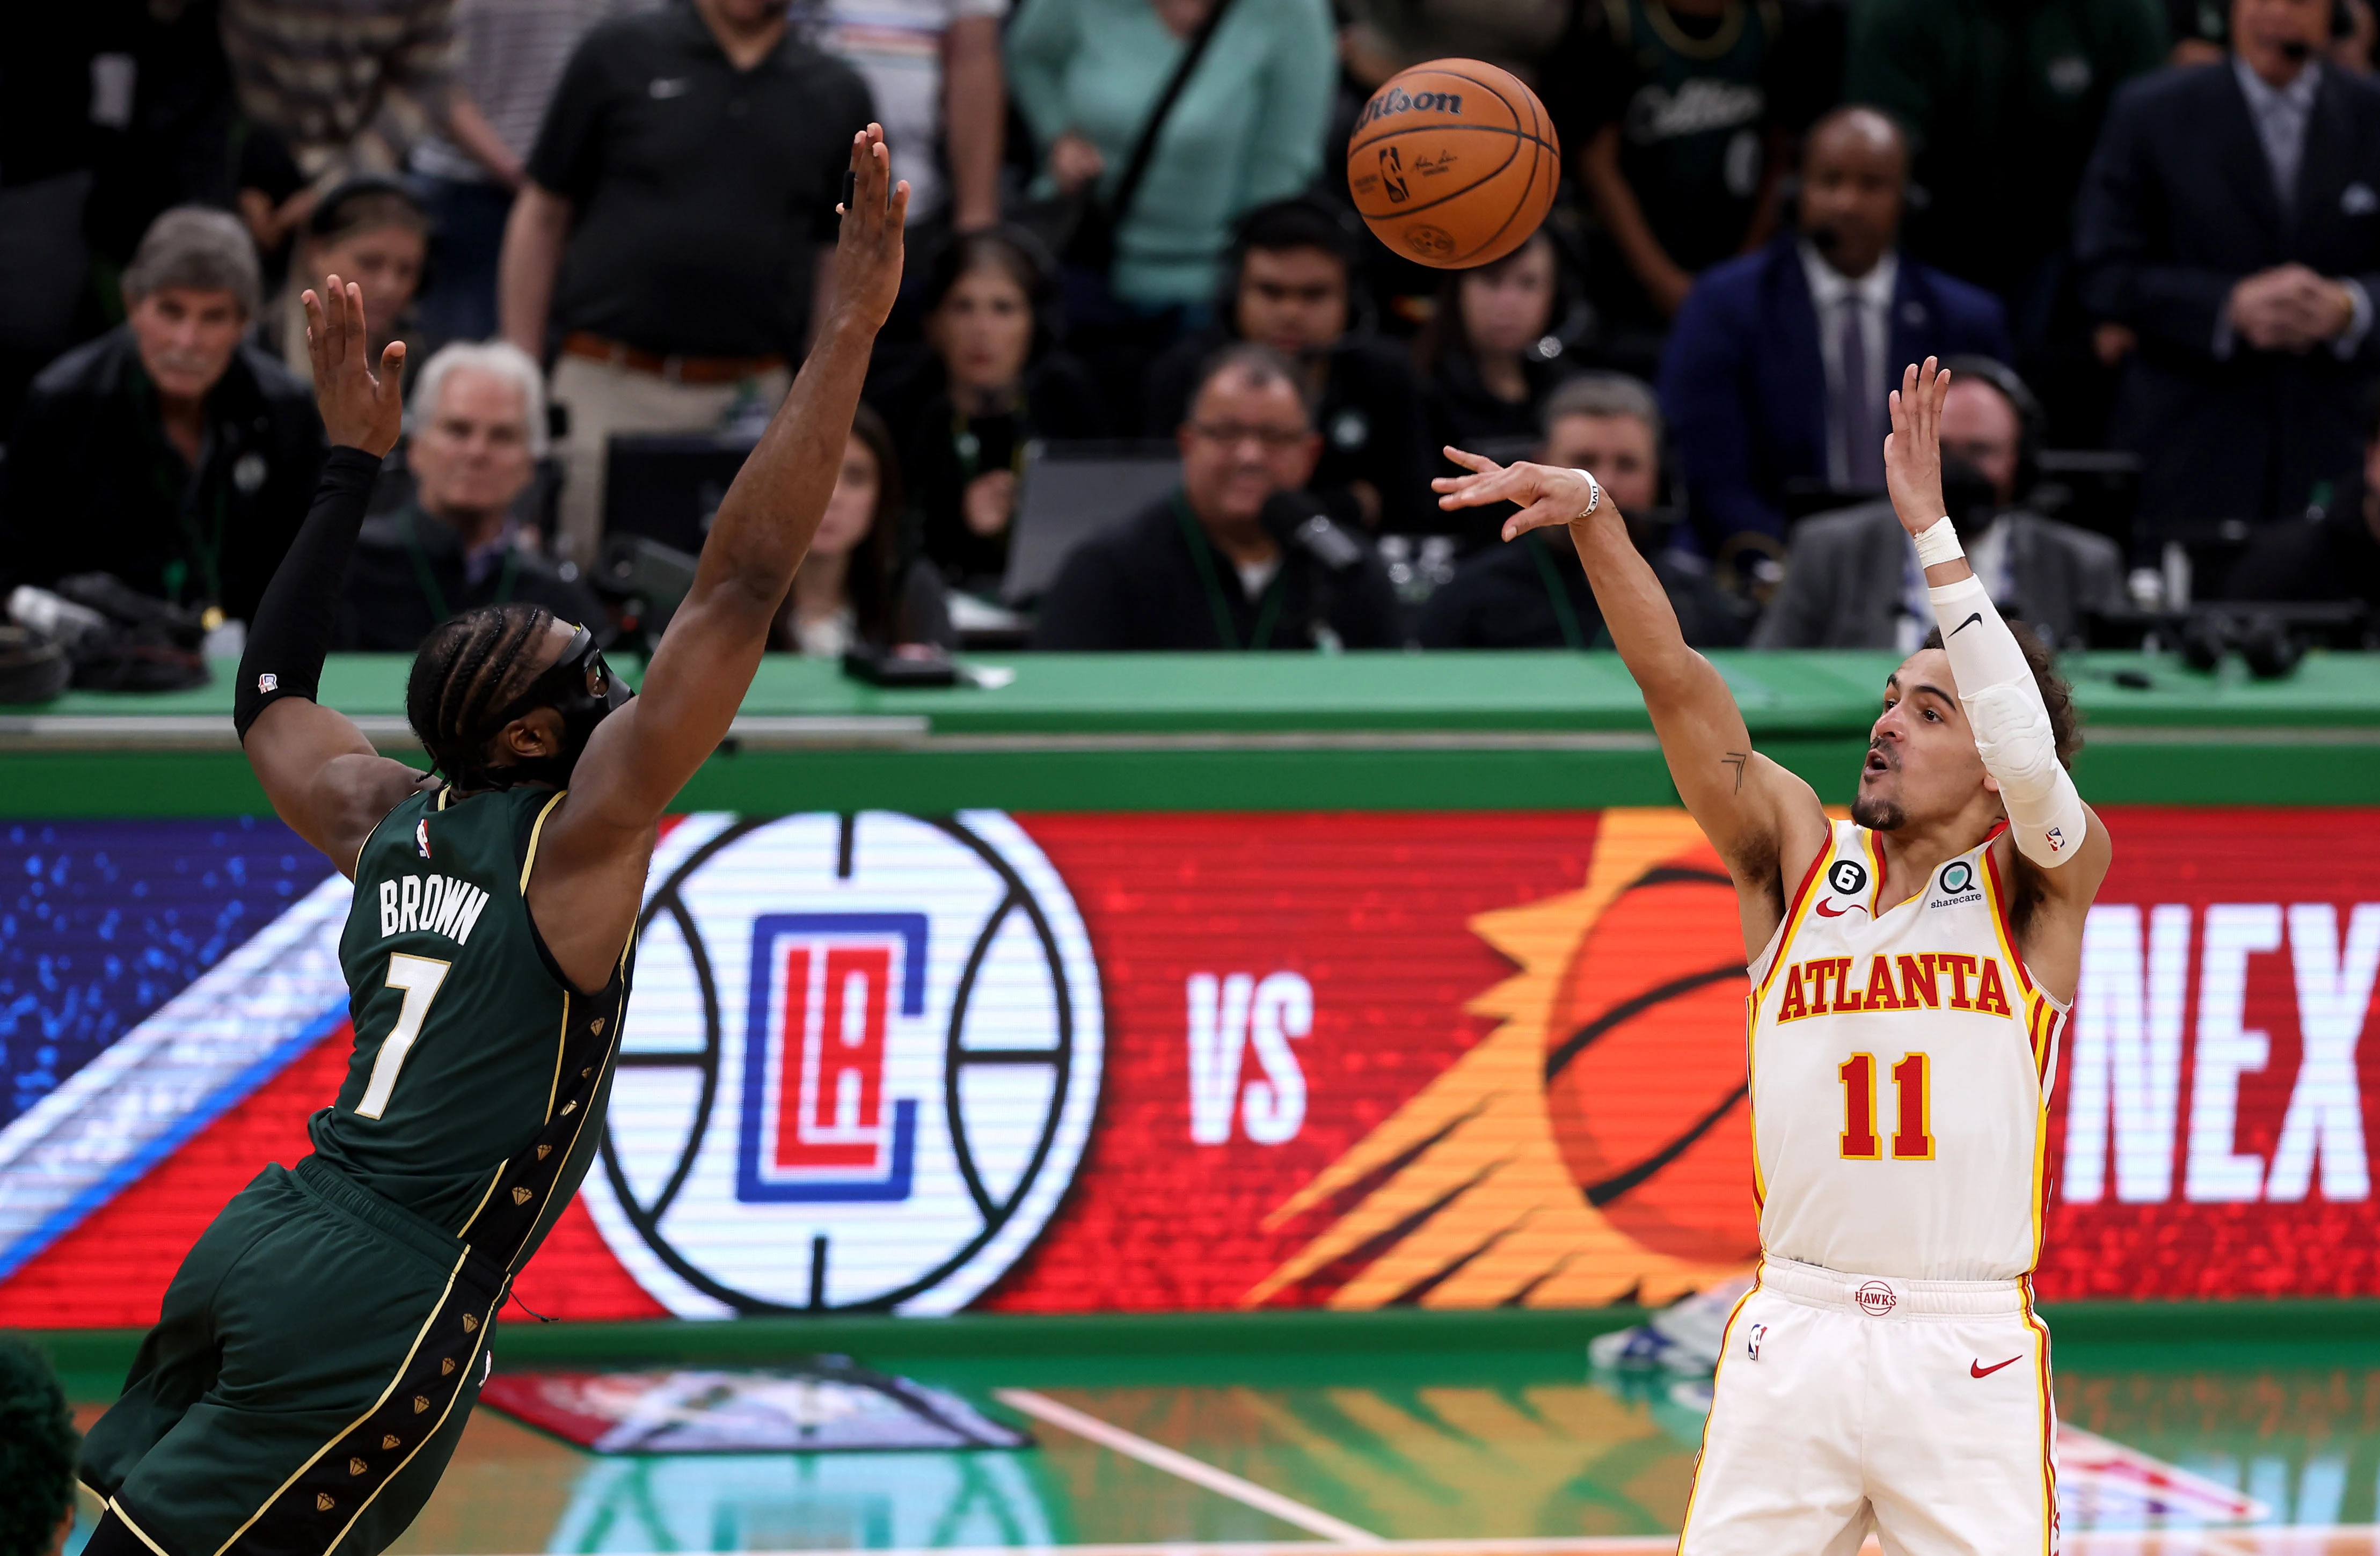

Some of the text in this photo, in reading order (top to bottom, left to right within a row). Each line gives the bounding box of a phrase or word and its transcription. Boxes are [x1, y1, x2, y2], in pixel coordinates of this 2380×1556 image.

[379, 874, 490, 946] BROWN
[1835, 864, 1860, 891] 6
[1931, 893, 1982, 909] sharecare
[1776, 952, 2013, 1026] ATLANTA
[354, 952, 452, 1120] 7
[1186, 971, 1314, 1145] VS
[1838, 1051, 1936, 1160] 11
[1855, 1291, 1896, 1306] HAWKS
